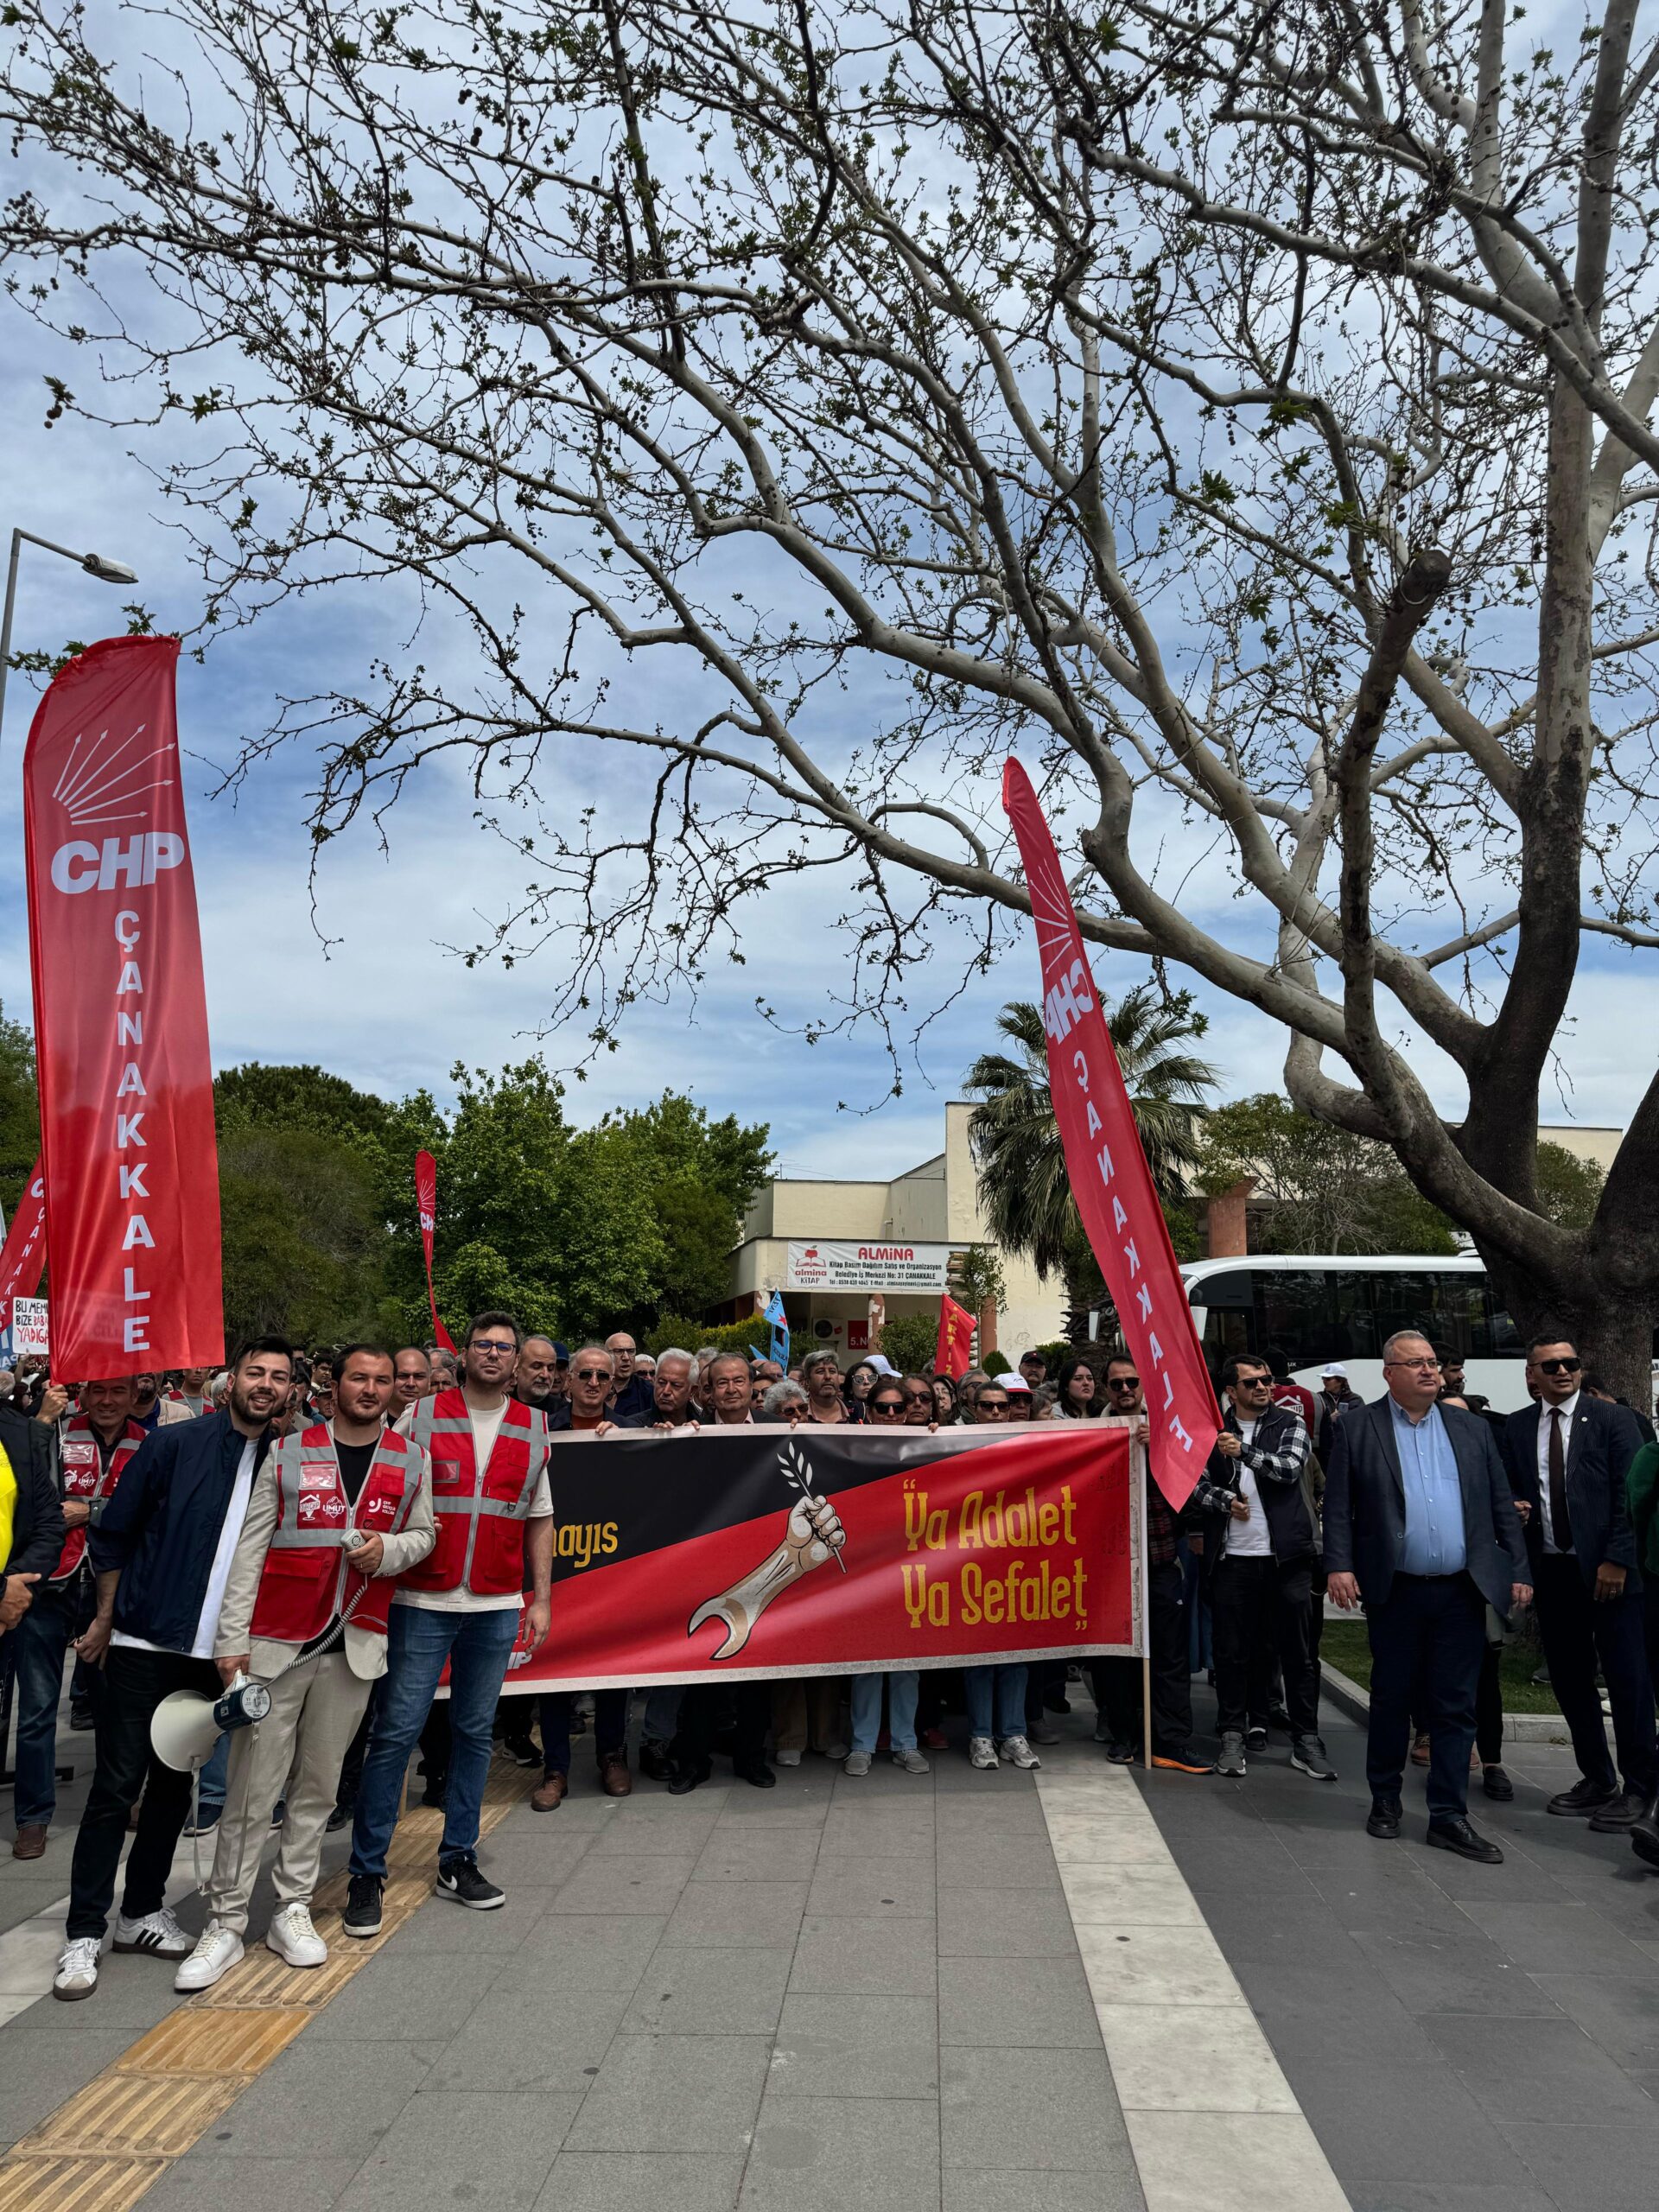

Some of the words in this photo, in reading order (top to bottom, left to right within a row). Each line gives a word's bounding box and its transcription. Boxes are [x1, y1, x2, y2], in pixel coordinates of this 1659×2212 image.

[51, 831, 185, 894] CHP
[115, 910, 156, 1353] ÇANAKKALE
[420, 1211, 433, 1231] CH
[16, 1300, 27, 1313] BU
[322, 1504, 346, 1513] UMUT
[958, 1484, 1077, 1549] Adalet
[552, 1522, 619, 1568] ayıs
[900, 1564, 950, 1629] Ya
